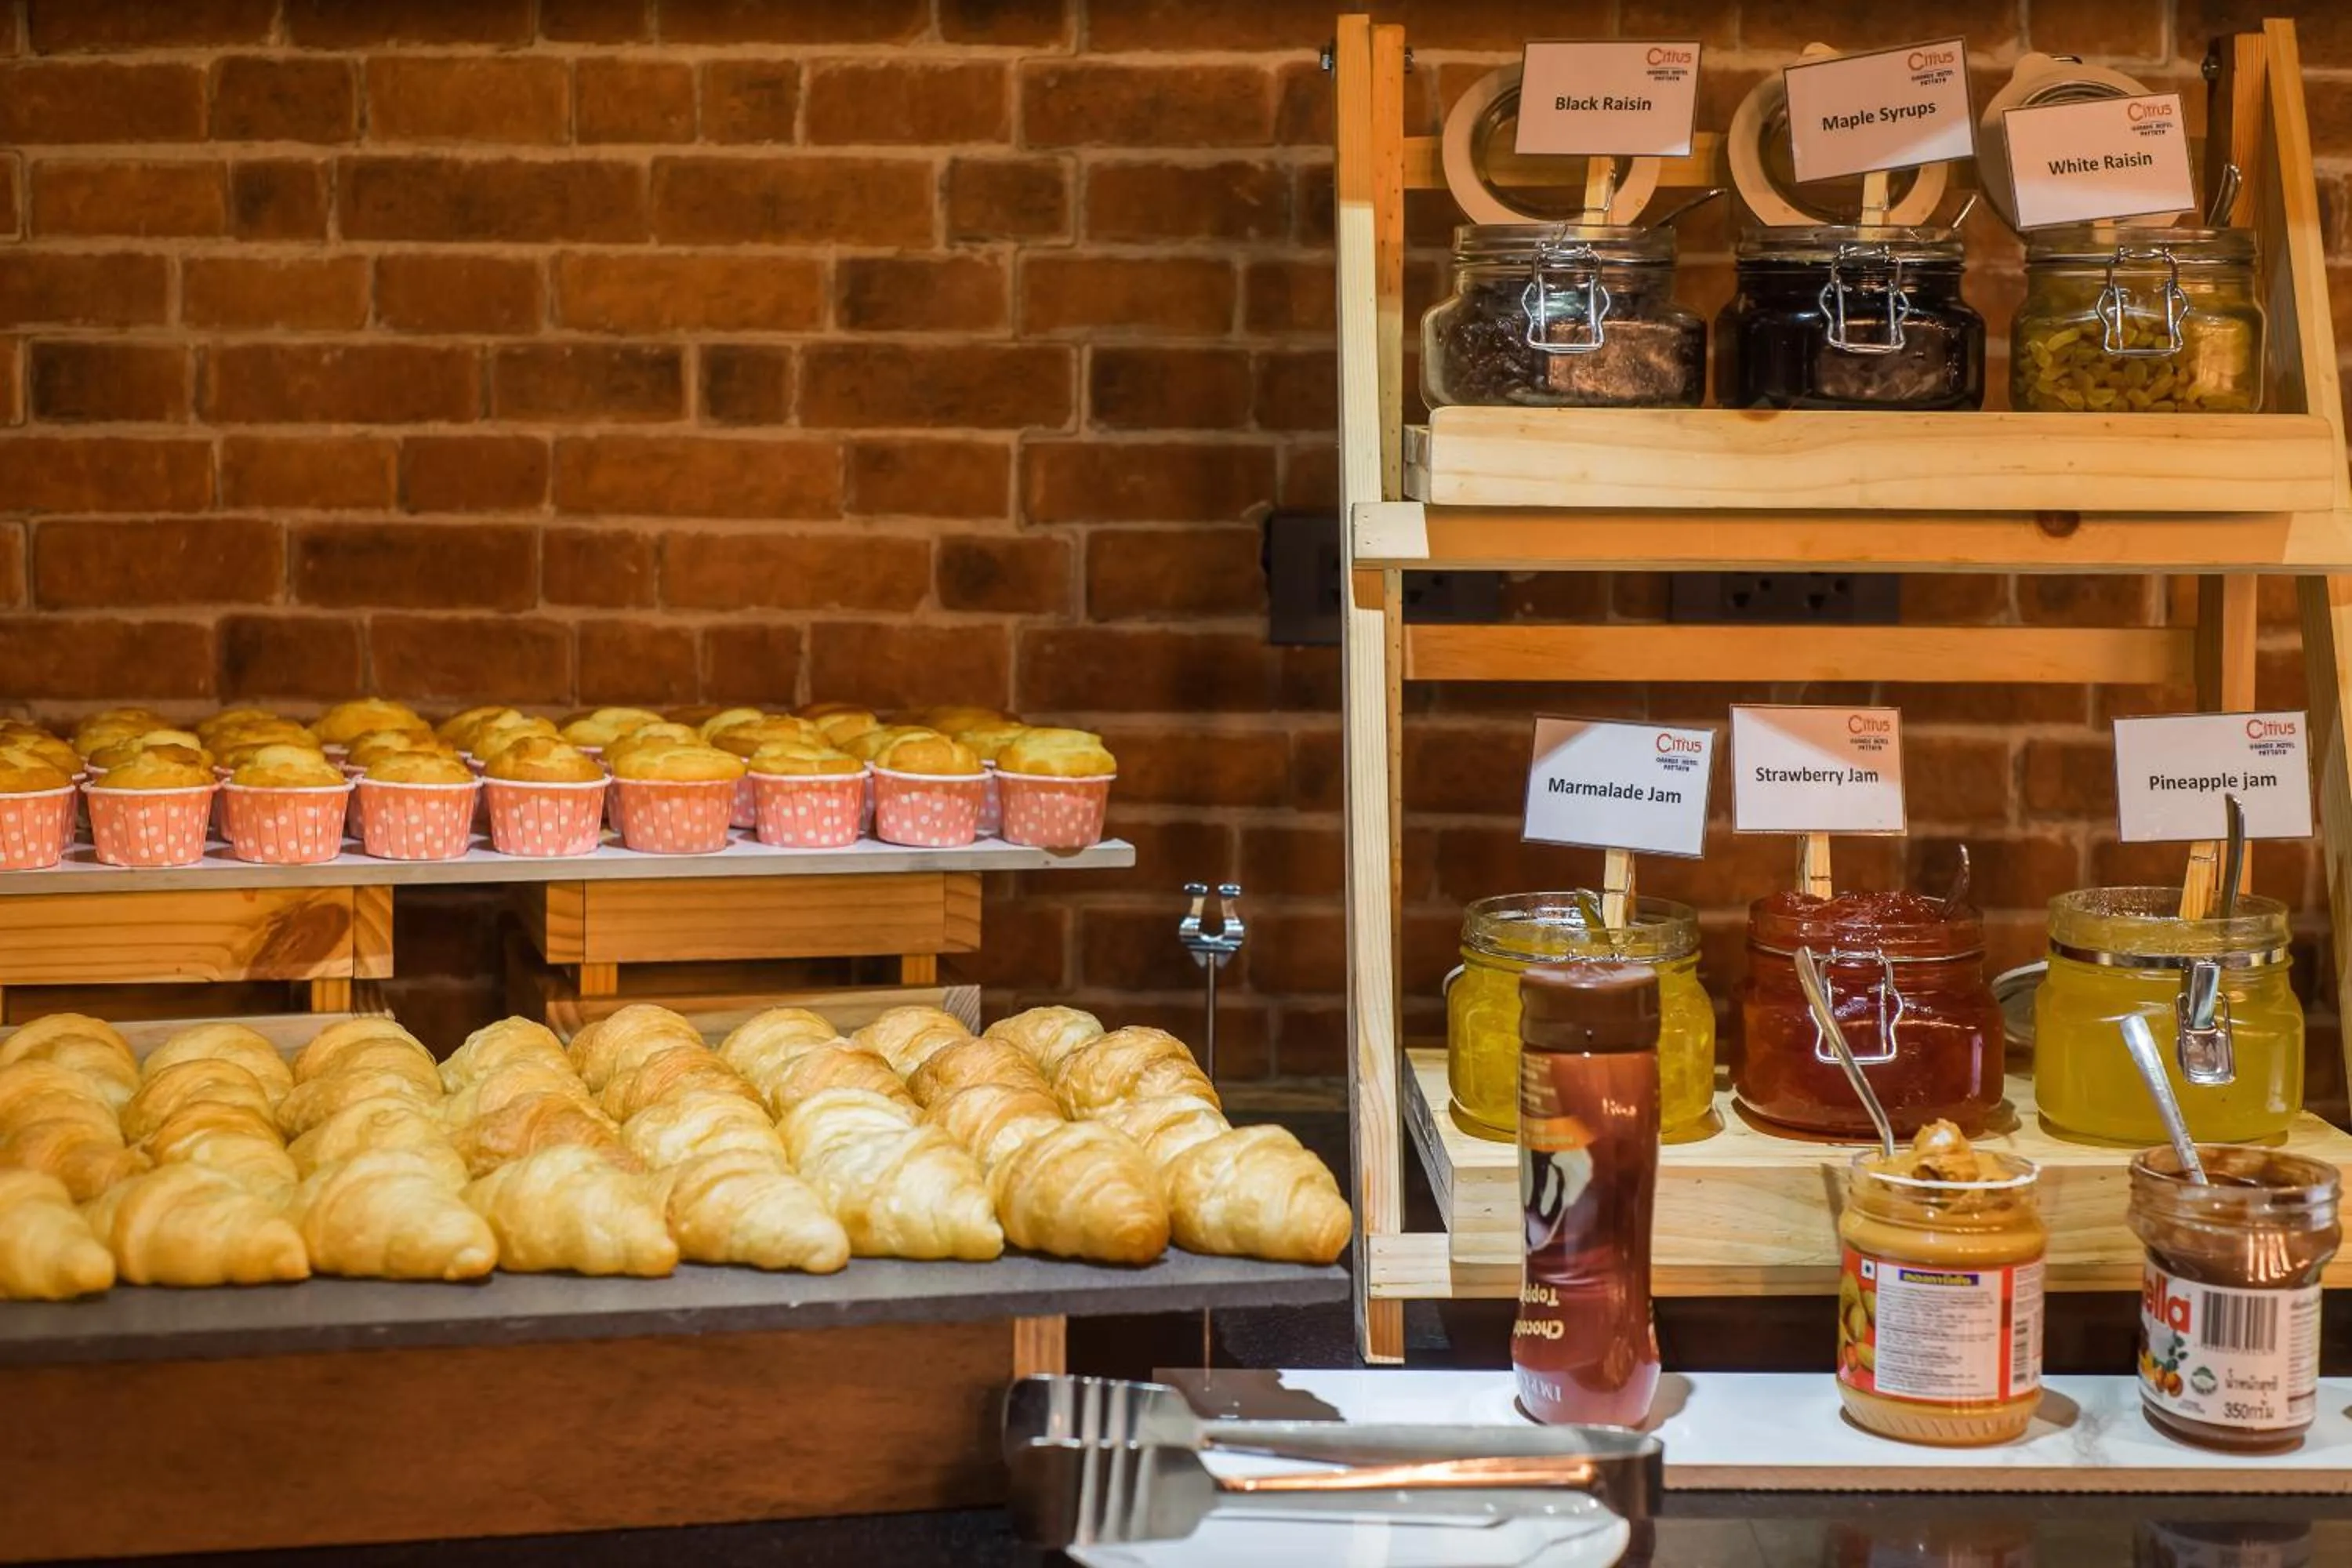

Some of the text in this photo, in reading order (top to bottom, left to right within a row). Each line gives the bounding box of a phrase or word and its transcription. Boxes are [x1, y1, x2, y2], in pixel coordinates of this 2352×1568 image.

[1647, 47, 1692, 66] Citrus
[1907, 50, 1954, 71] Citrus
[1555, 94, 1652, 111] Black Raisin
[2127, 102, 2172, 122] Citrus
[1821, 102, 1936, 131] Maple Syrups
[2048, 151, 2153, 175] White Raisin
[1848, 714, 1891, 734] Citrus
[2245, 719, 2296, 739] Citrus
[1656, 733, 1702, 753] Citrus
[1755, 766, 1879, 786] Strawberry Jam
[2149, 771, 2278, 793] Pineapple jam
[1548, 777, 1682, 804] Marmalade Jam
